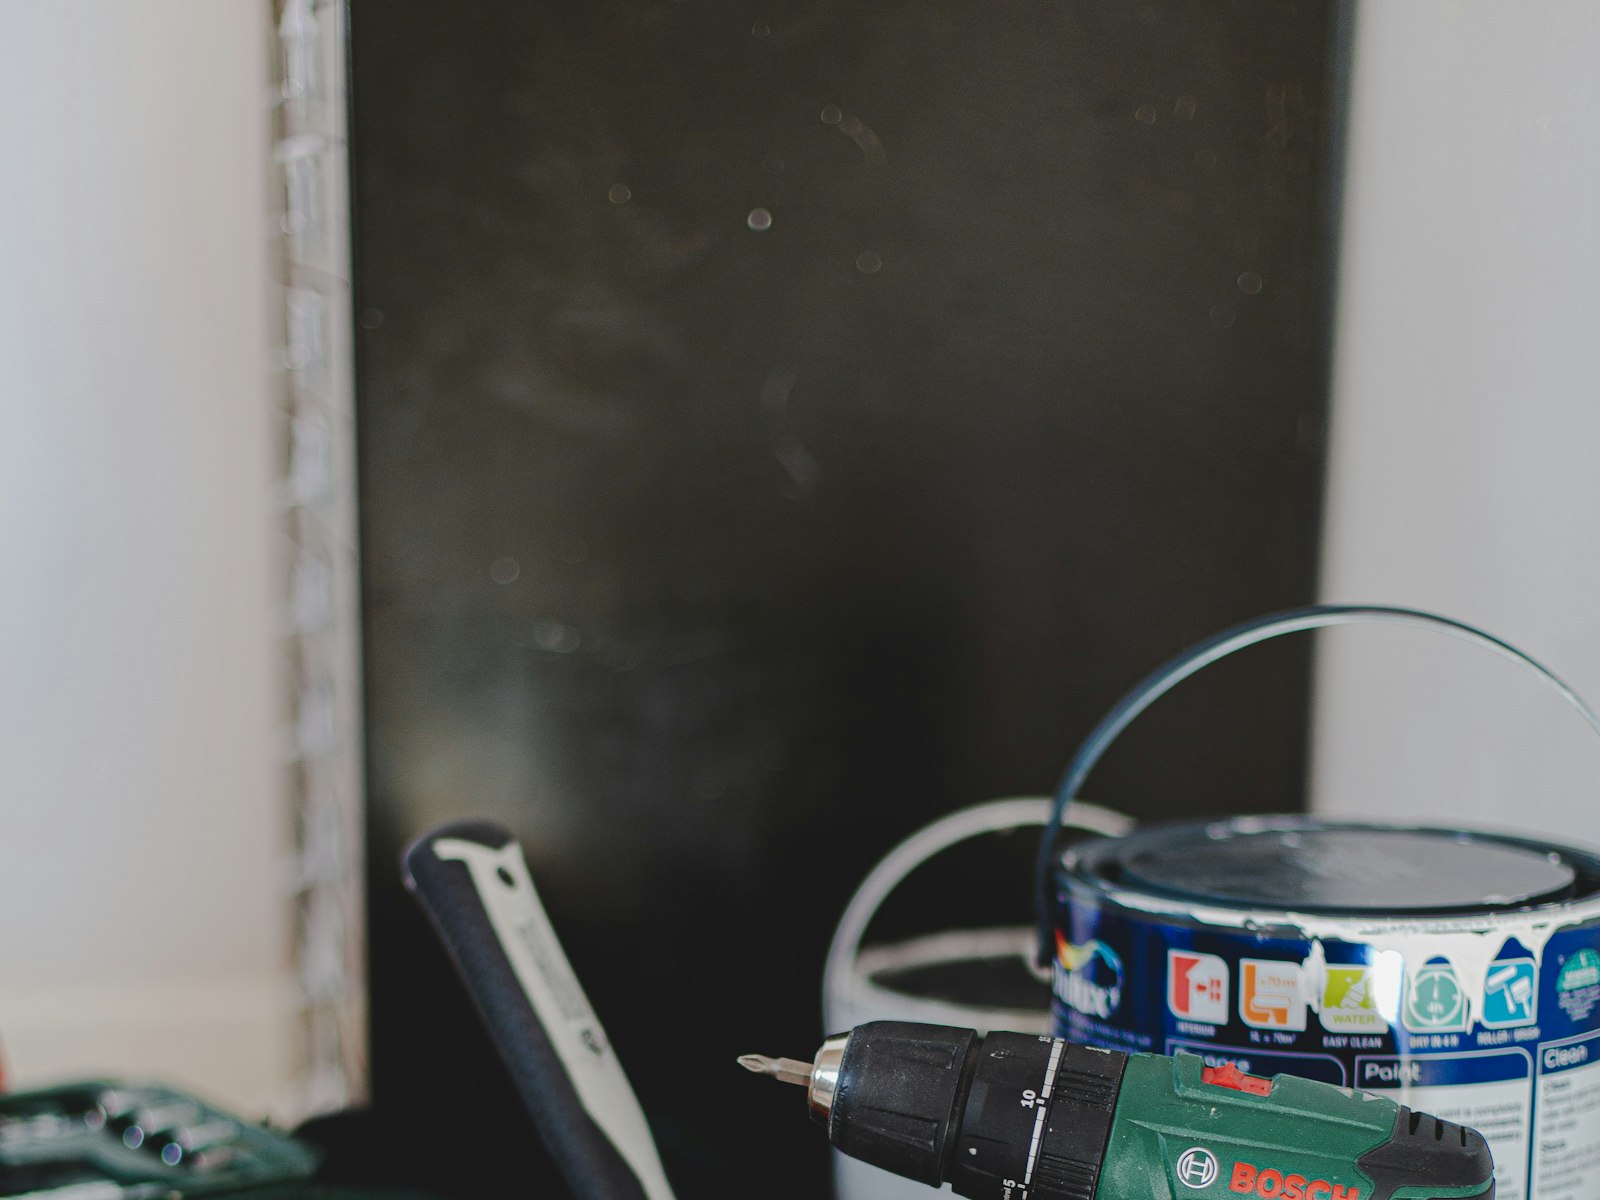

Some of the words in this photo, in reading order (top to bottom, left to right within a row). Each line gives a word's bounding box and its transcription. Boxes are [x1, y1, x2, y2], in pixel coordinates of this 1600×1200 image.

[1333, 1014, 1377, 1026] WATER
[1323, 1036, 1348, 1049] EASY
[1350, 1036, 1382, 1049] CLEAN
[1543, 1045, 1588, 1069] Clean
[1020, 1089, 1037, 1110] 10
[1003, 1178, 1016, 1188] 5
